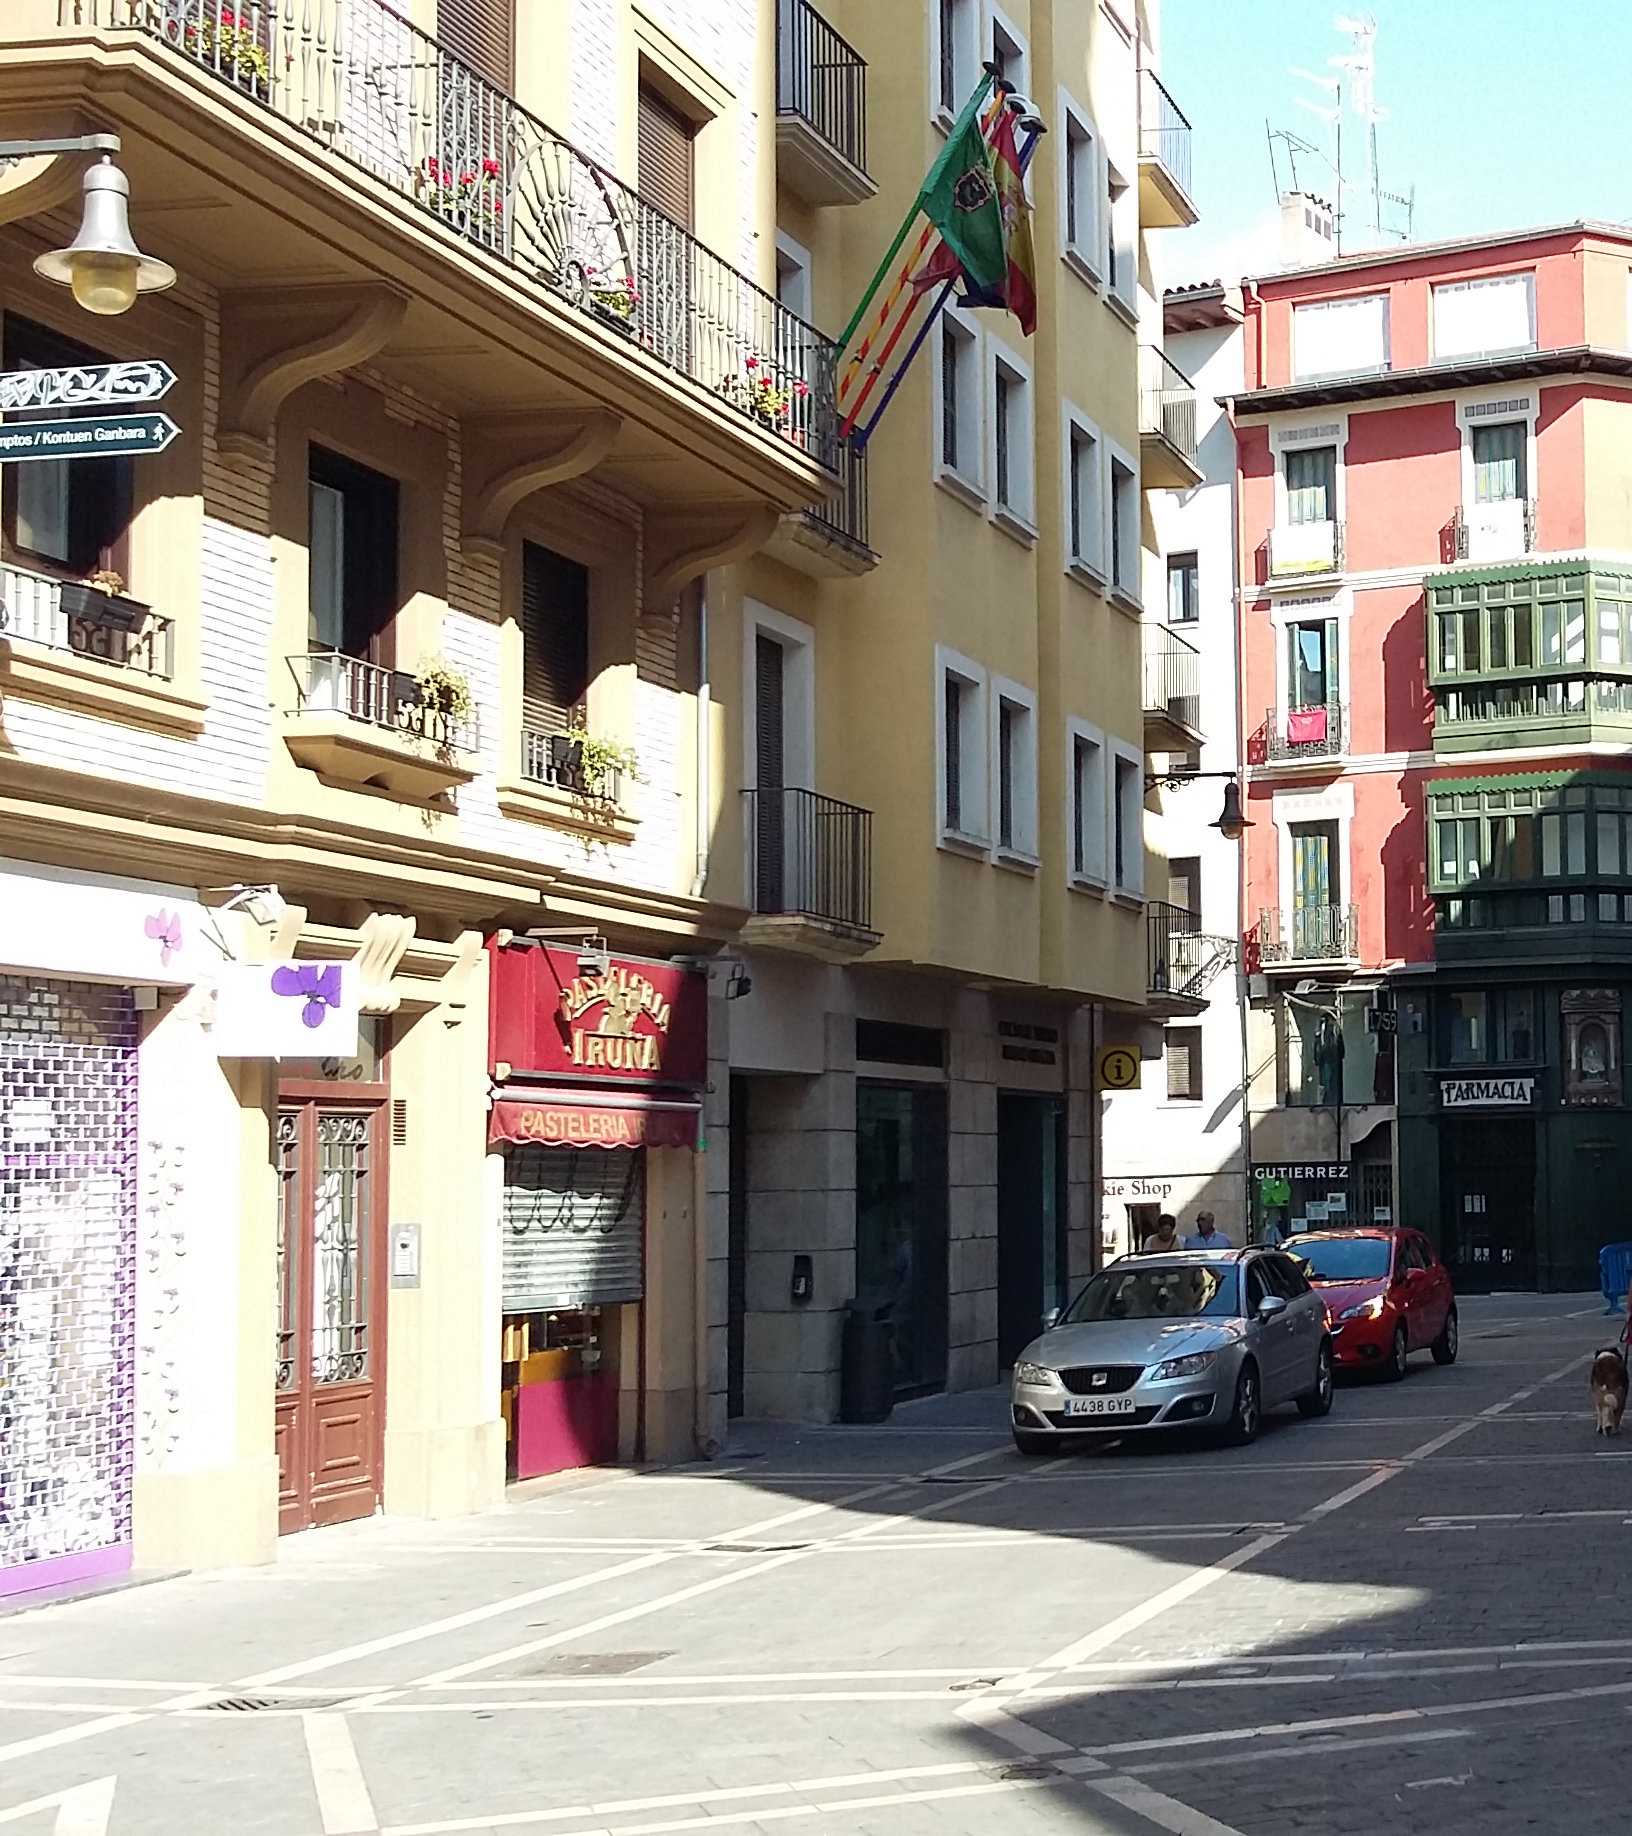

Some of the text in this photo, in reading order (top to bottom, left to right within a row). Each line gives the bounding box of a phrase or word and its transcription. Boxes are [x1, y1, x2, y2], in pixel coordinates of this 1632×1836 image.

[43, 430, 92, 445] Kontuen
[95, 426, 146, 442] Ganbara
[1445, 1081, 1528, 1103] FARMACIA
[520, 1110, 631, 1140] PASTELERIA
[1254, 1165, 1349, 1180] GUTIERREZ
[1131, 1178, 1172, 1199] Shop
[1073, 1398, 1132, 1413] 4438 GYP
